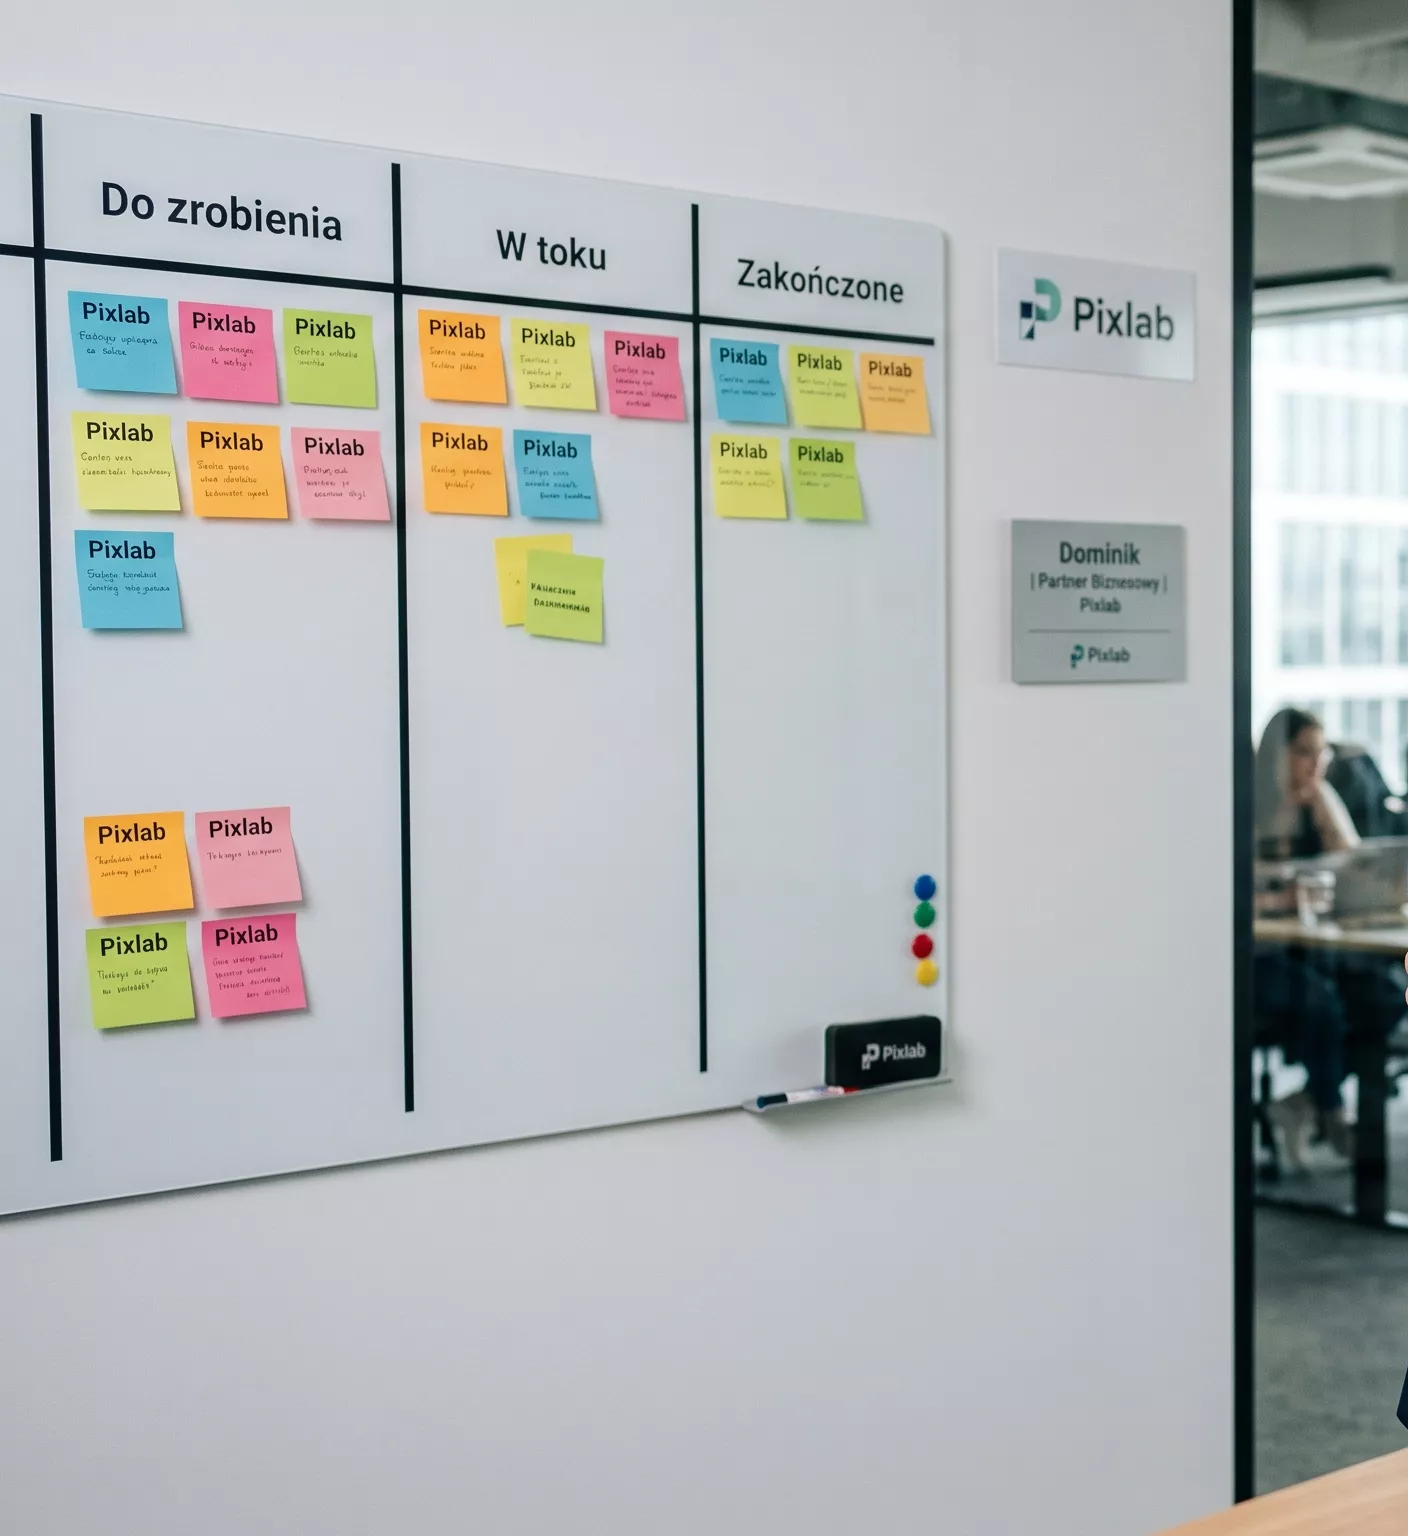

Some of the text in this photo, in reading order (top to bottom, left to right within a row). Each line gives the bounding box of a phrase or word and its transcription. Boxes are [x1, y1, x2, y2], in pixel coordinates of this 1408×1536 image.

[102, 181, 342, 241] Do zrobienia
[496, 229, 607, 270] W toku
[737, 258, 904, 303] Zakończone
[82, 302, 151, 325] Pixlab
[192, 311, 257, 335] Pixlab
[1073, 296, 1175, 342] Pixlab
[295, 318, 356, 340] Pixlab
[429, 319, 486, 340] Pixlab
[522, 327, 576, 348] Pixlab
[614, 340, 666, 360] Pixlab
[719, 347, 768, 367] Pixlab
[797, 353, 843, 371] Pixlab
[868, 361, 913, 378] Pixlab
[86, 421, 154, 442] Pixlab
[200, 431, 264, 452] Pixlab
[432, 432, 489, 451] Pixlab
[304, 437, 365, 457] Pixlab
[524, 439, 578, 459] Pixlab
[720, 442, 768, 460] Pixlab
[797, 446, 844, 463] Pixlab
[88, 540, 156, 559] Pixlab
[1059, 541, 1141, 565] Dominik
[1038, 572, 1088, 589] Partner
[1080, 597, 1122, 613] Pixlab
[1088, 647, 1131, 663] Pixlab
[98, 822, 166, 844] Pixlab
[209, 816, 273, 838] Pixlab
[100, 932, 168, 956] Pixlab
[215, 923, 278, 947] Pixlab
[882, 1042, 927, 1062] Pixlab
